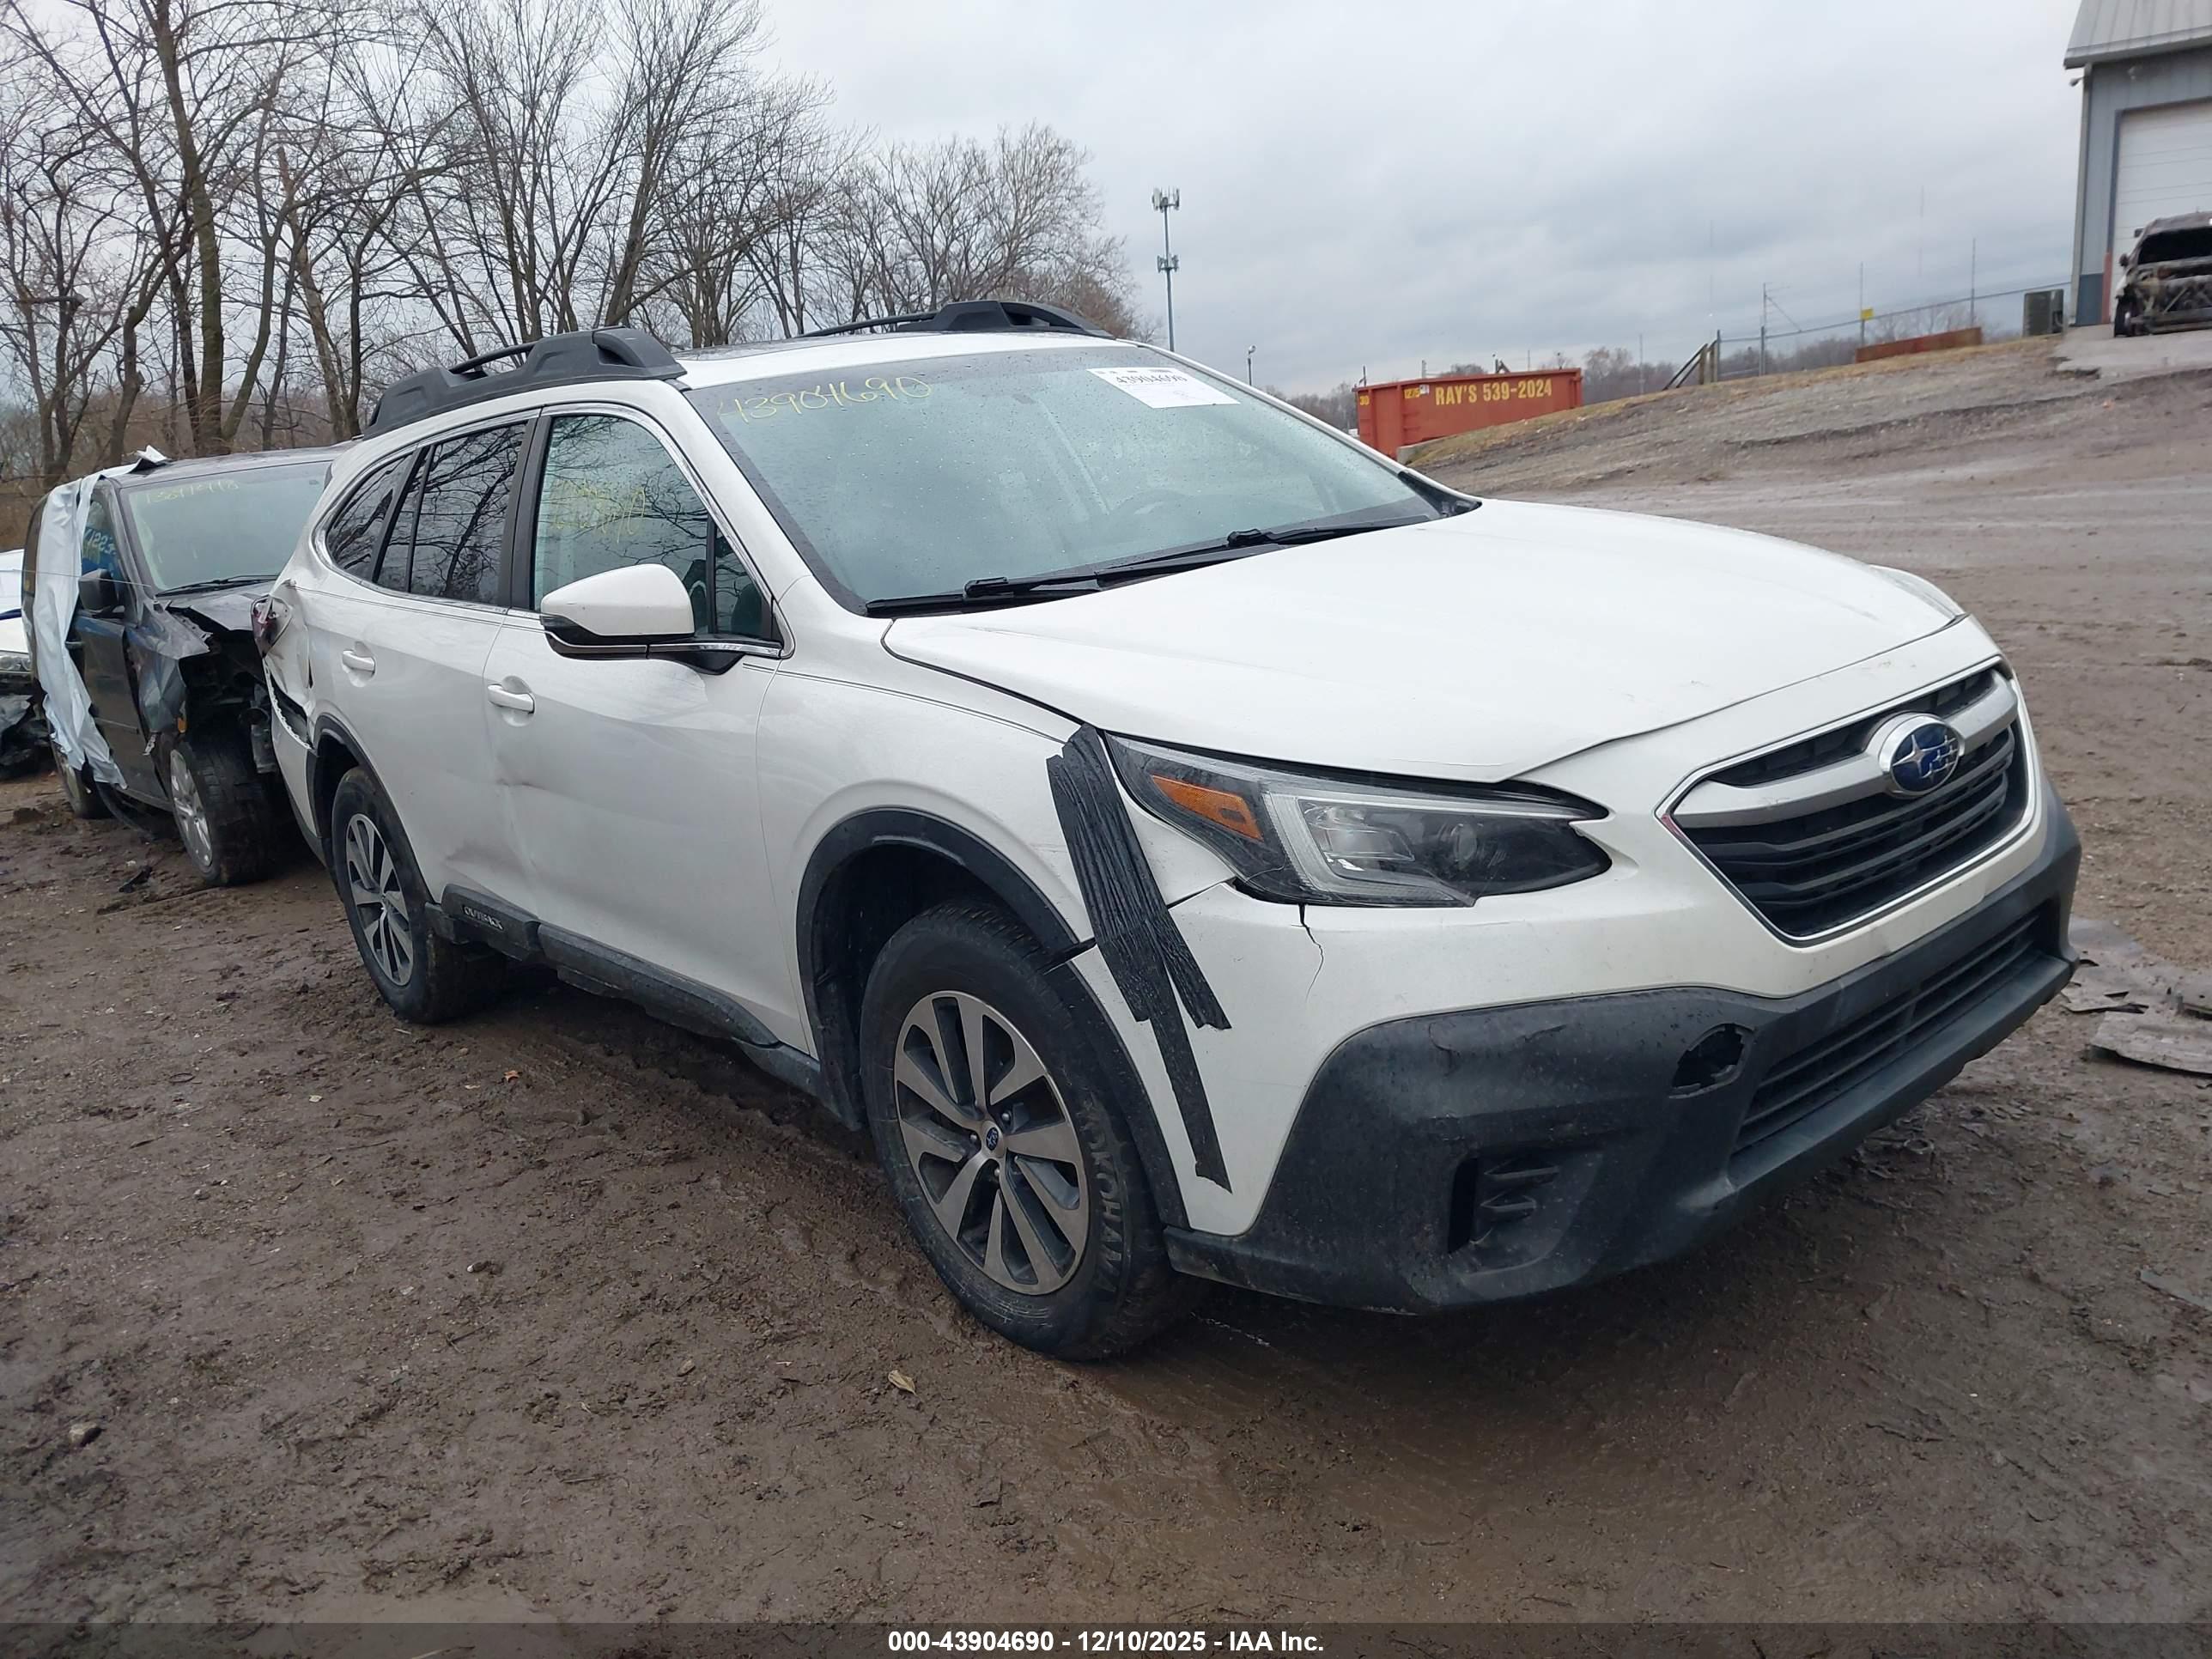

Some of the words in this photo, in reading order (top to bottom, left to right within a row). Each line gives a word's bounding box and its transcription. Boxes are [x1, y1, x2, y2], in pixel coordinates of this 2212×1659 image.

[716, 376, 933, 424] 43904690
[1435, 384, 1478, 406] RAY'S
[1483, 378, 1553, 402] 539-2024
